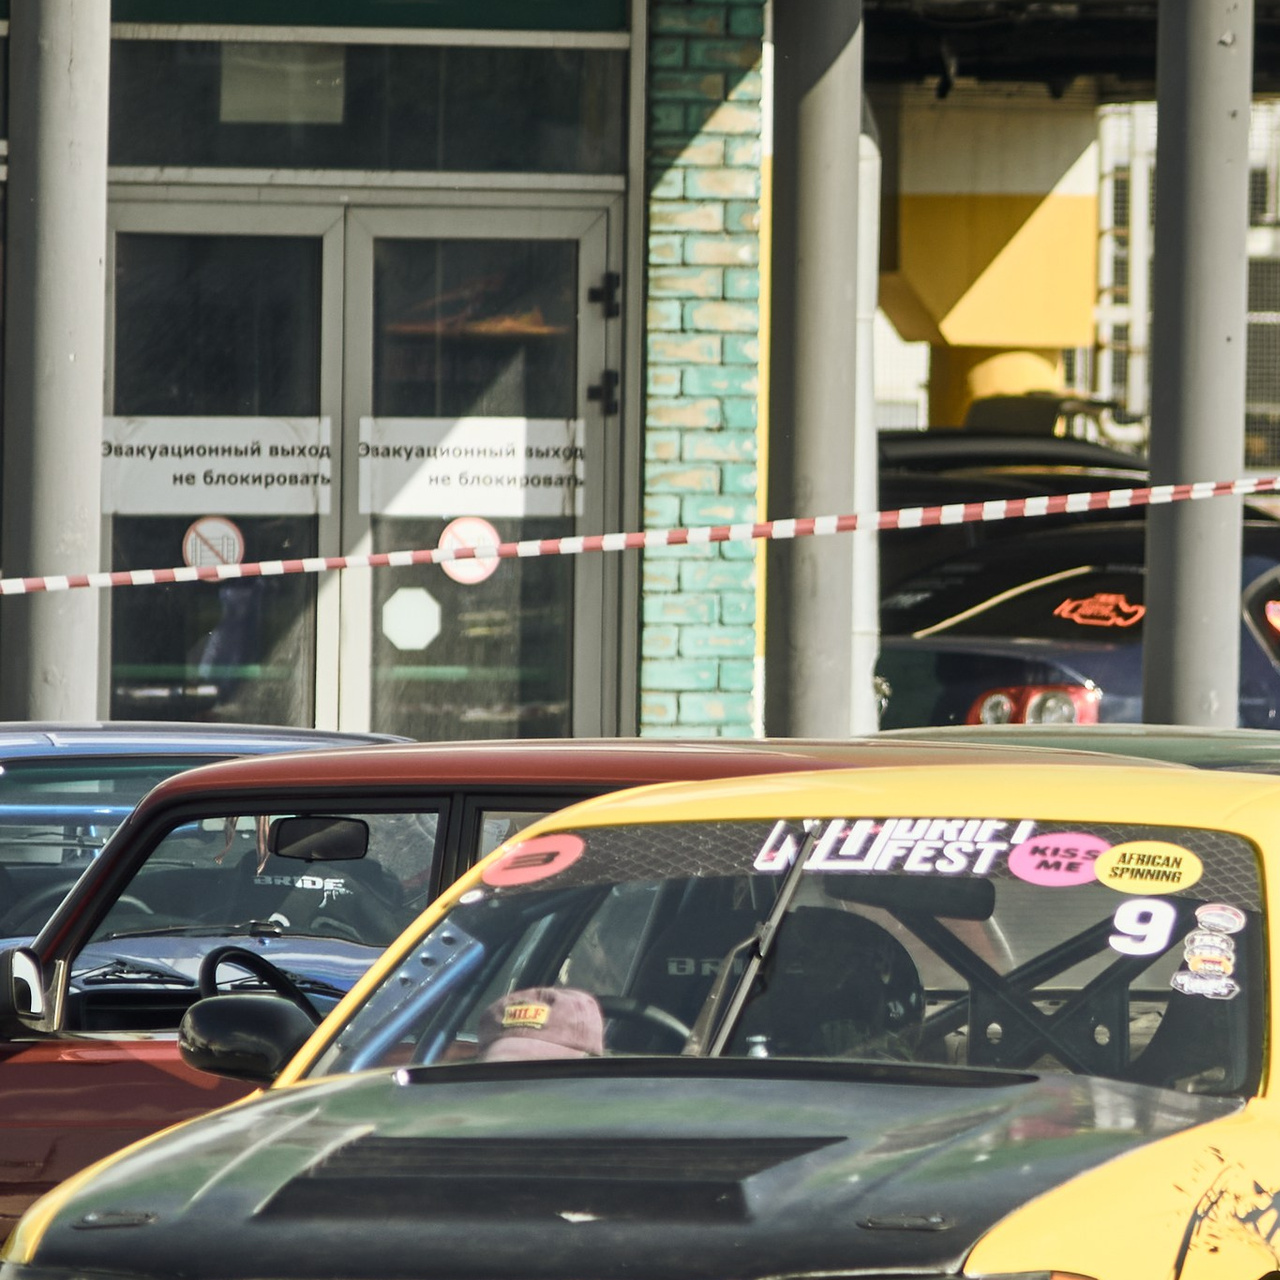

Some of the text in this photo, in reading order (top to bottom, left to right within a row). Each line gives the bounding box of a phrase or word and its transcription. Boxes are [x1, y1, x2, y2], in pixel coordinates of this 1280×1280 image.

[101, 440, 331, 460] Эвакуационный выход
[358, 441, 585, 462] Эвакуационный выход
[172, 469, 331, 489] не блокировать
[428, 471, 585, 489] не блокировать
[873, 840, 1009, 873] FEST
[1030, 846, 1103, 860] KISS
[1118, 852, 1183, 869] AFRICAN
[1035, 859, 1084, 872] ME
[253, 875, 345, 891] BRIDE
[1109, 867, 1182, 883] SPINNING
[1108, 898, 1177, 956] 9
